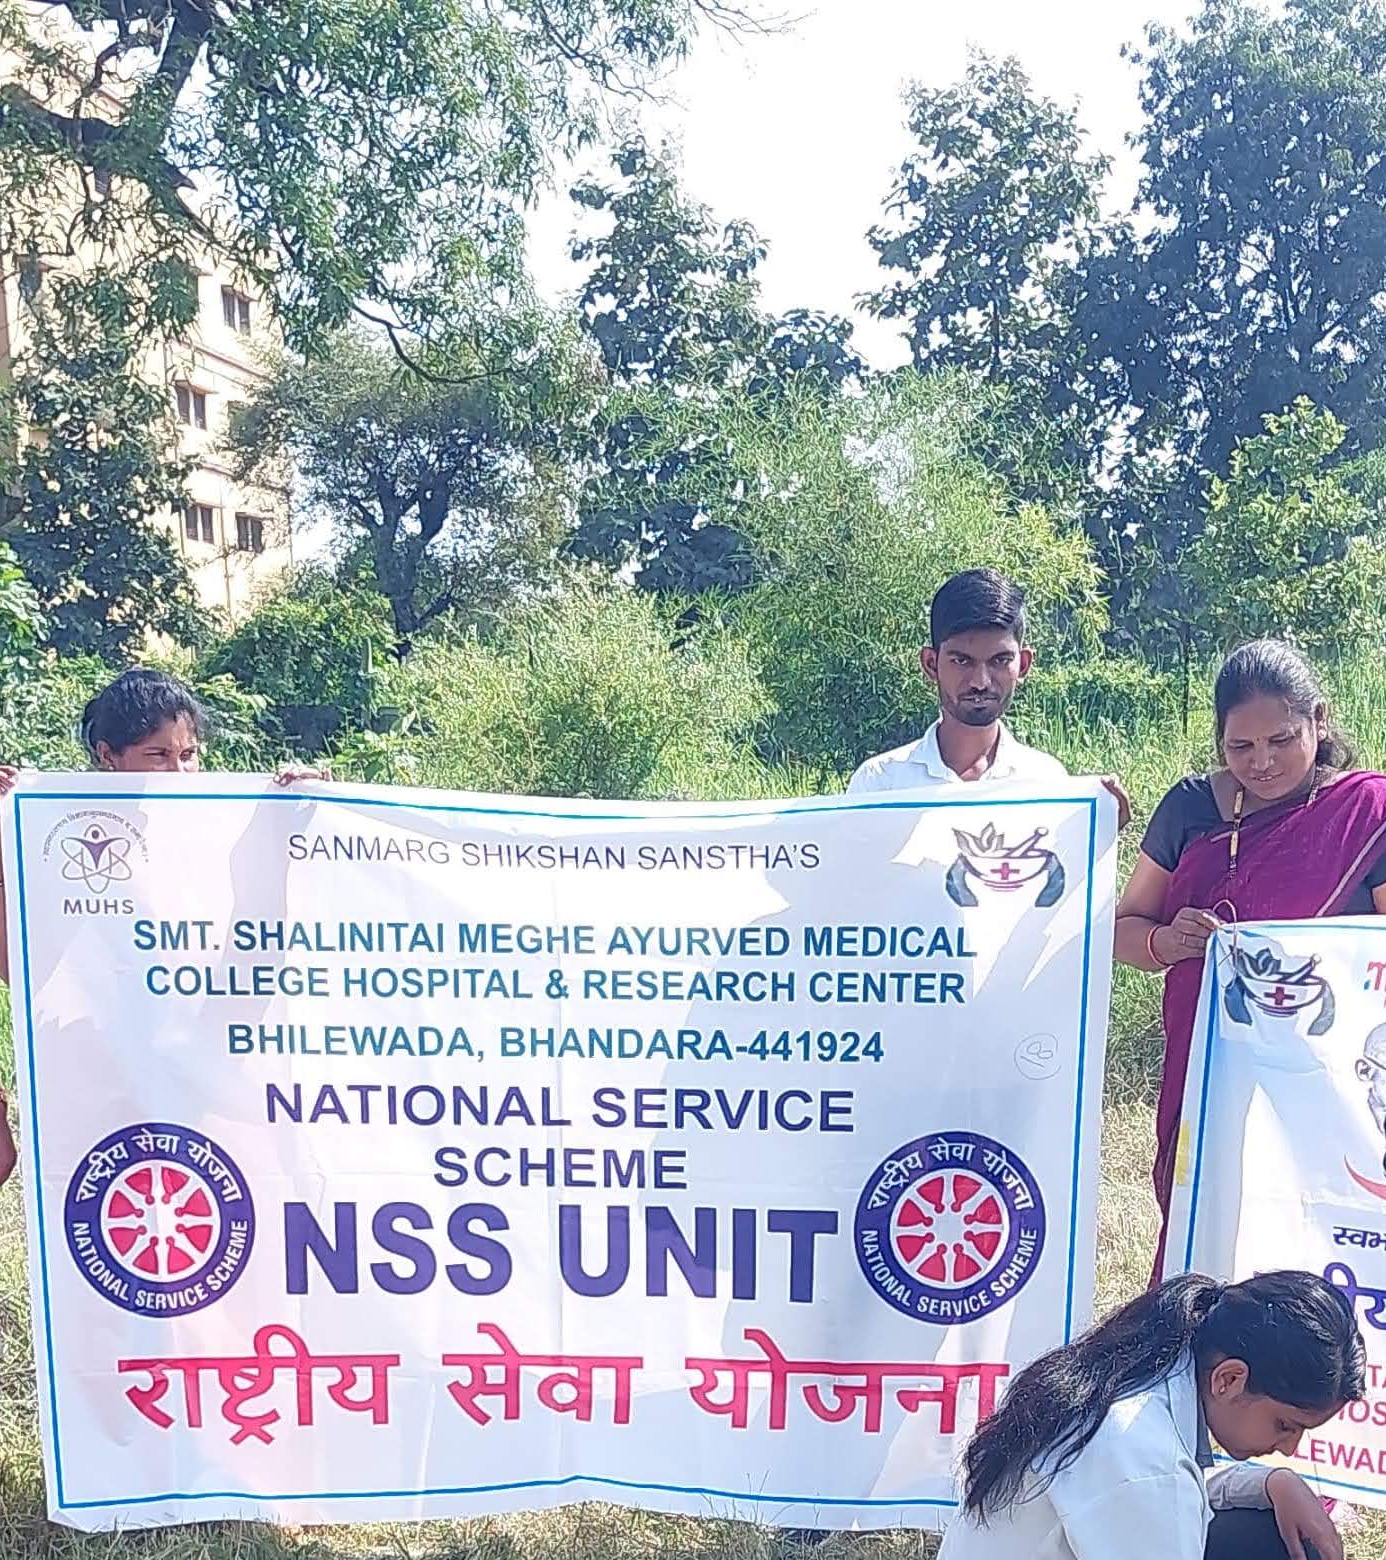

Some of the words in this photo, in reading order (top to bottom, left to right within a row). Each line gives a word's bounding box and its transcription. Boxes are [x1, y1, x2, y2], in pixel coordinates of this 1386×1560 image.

[288, 835, 450, 866] SANMARG
[462, 842, 626, 870] SHIKSHAN
[638, 843, 821, 870] SANSTHA'S
[63, 898, 134, 915] MUHS
[133, 919, 221, 952] SMT.
[233, 920, 445, 954] SHALINITAI
[458, 923, 596, 955] MEGHE
[607, 925, 790, 957] AYURVED
[803, 925, 977, 958] MEDICAL
[145, 965, 330, 997] COLLEGE
[344, 967, 534, 1000] HOSPITAL
[545, 970, 570, 999] &
[584, 969, 796, 1003] RESEARCH
[808, 971, 966, 1004] CENTER
[228, 1023, 485, 1062] BHILEWADA,
[500, 1026, 885, 1064] BHANDARA-441924
[265, 1082, 572, 1127] NATIONAL
[592, 1087, 856, 1133] SERVICE
[76, 1141, 129, 1203] राष्ट्रीय
[131, 1128, 181, 1155] सेवा
[187, 1141, 243, 1203] योजना
[433, 1146, 689, 1190] SCHEME
[867, 1152, 923, 1210] राष्ट्रीय
[928, 1137, 976, 1161] सेवा
[983, 1149, 1034, 1212] योजना
[72, 1223, 129, 1301] NATIONAL
[135, 1283, 209, 1310] SERVICE
[205, 1221, 248, 1291] SCHEME
[283, 1201, 514, 1296] NSS
[558, 1204, 839, 1303] UNIT
[861, 1230, 912, 1306] NATIONAL
[917, 1290, 992, 1316] SERVICE
[989, 1229, 1037, 1298] SCHEME
[118, 1323, 401, 1446] राष्ट्रीय
[443, 1322, 644, 1425] सेवा
[686, 1328, 1011, 1436] योजना
